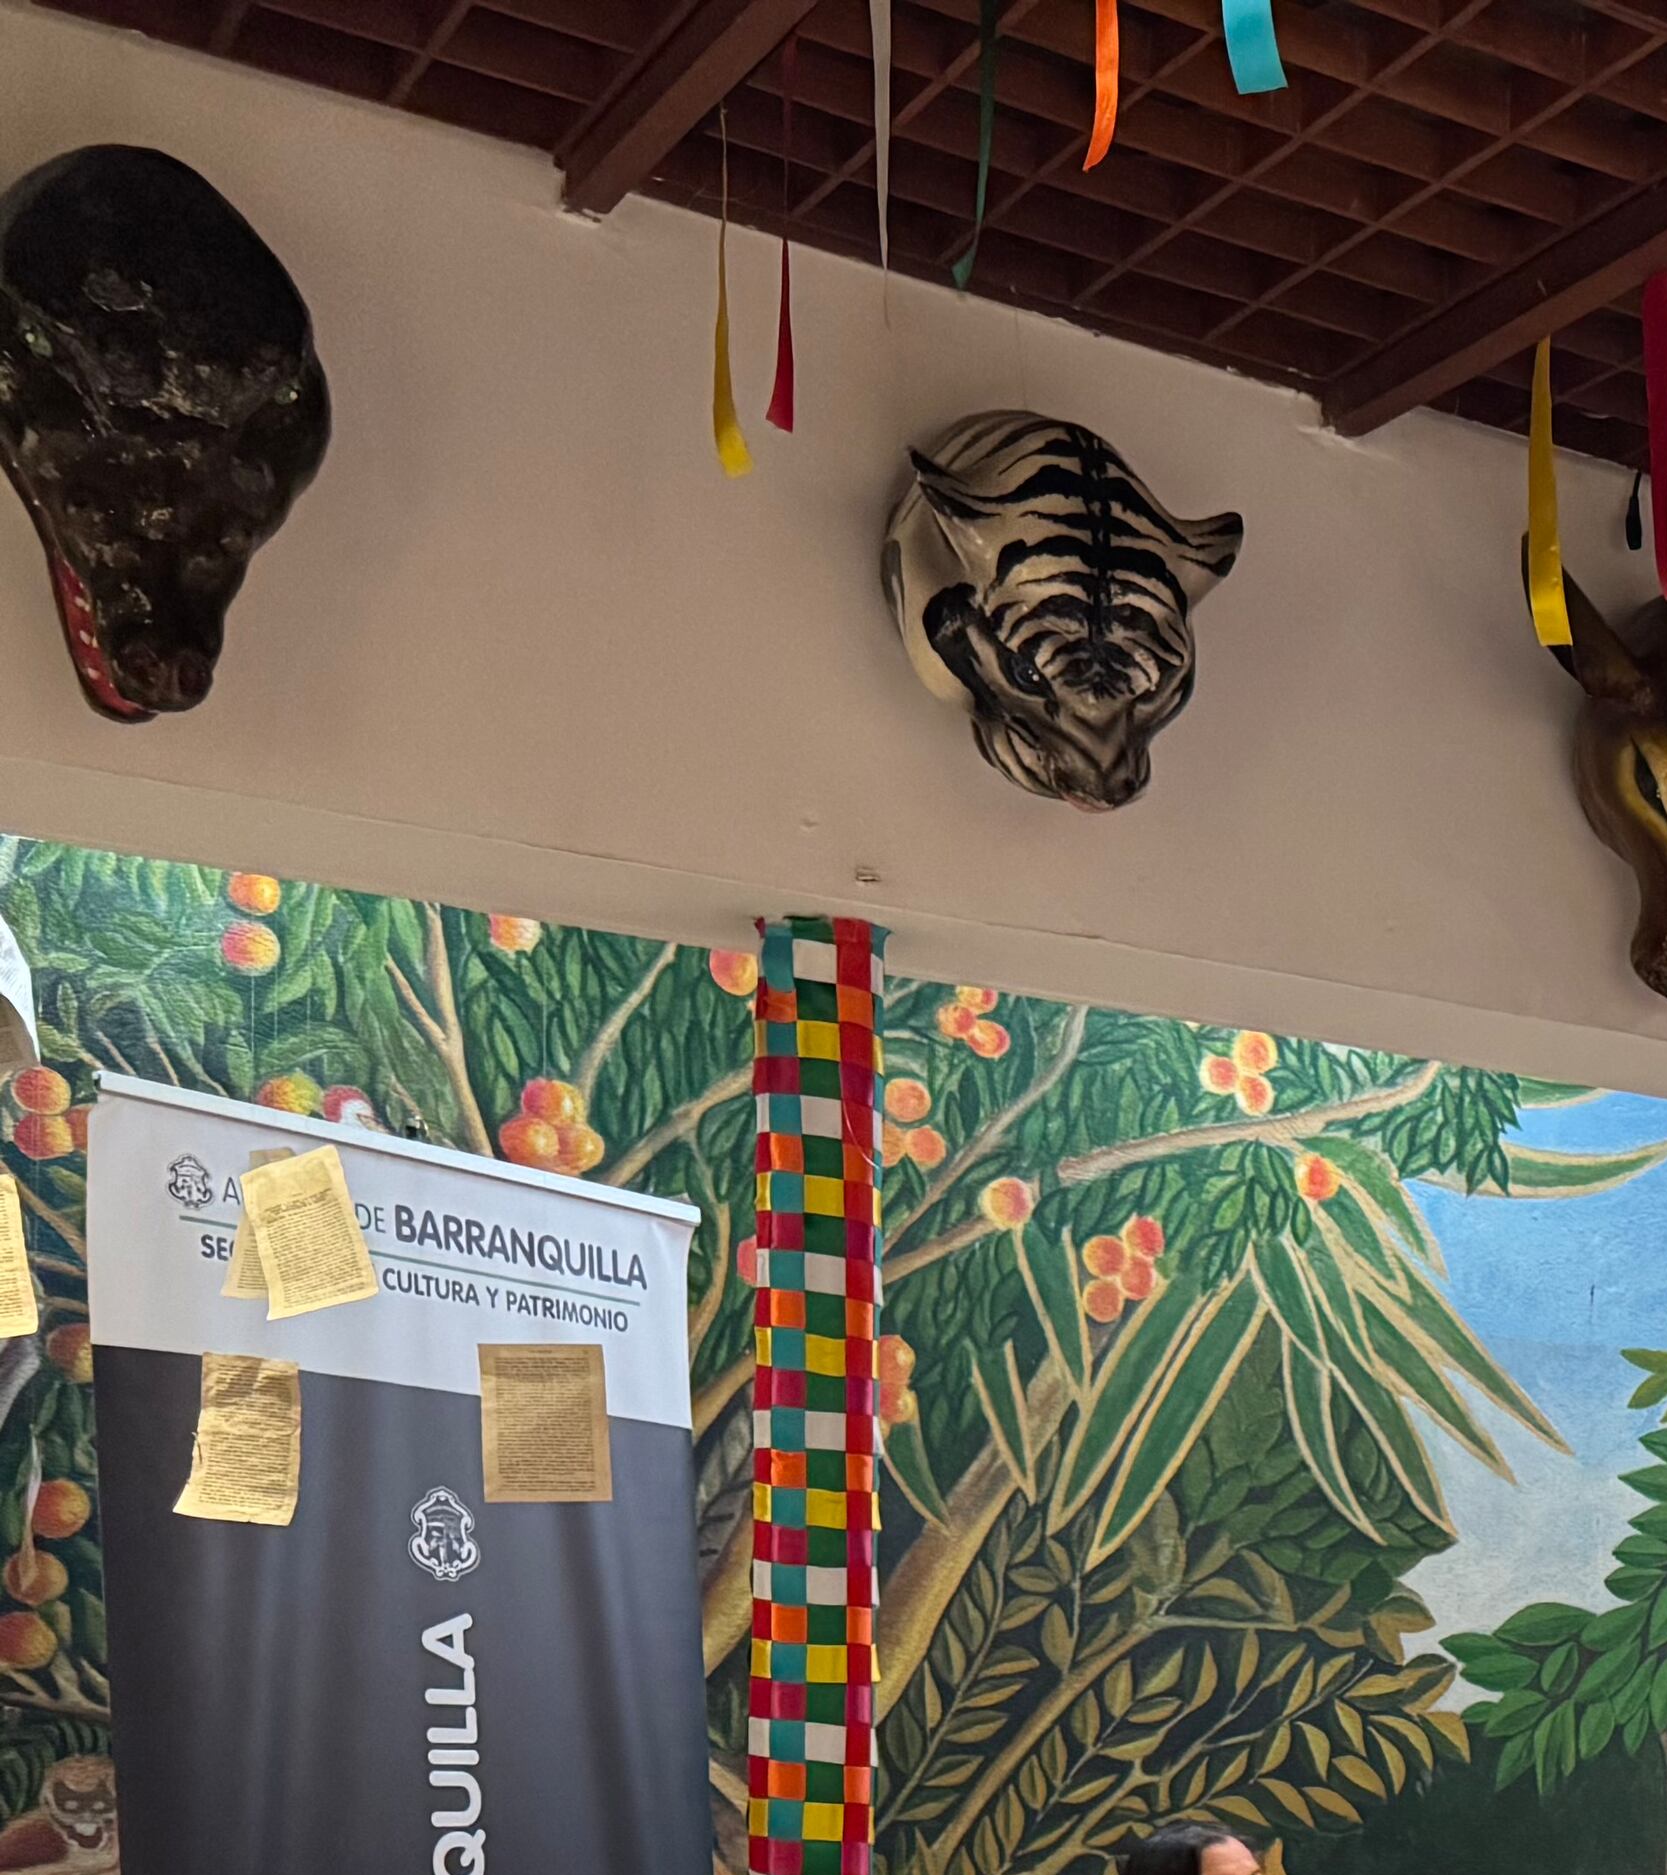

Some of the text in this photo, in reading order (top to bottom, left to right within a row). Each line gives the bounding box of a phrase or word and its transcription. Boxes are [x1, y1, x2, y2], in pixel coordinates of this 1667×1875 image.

[394, 1202, 647, 1291] BARRANQUILLA
[382, 1267, 629, 1334] CULTURA Y PATRIMONIO
